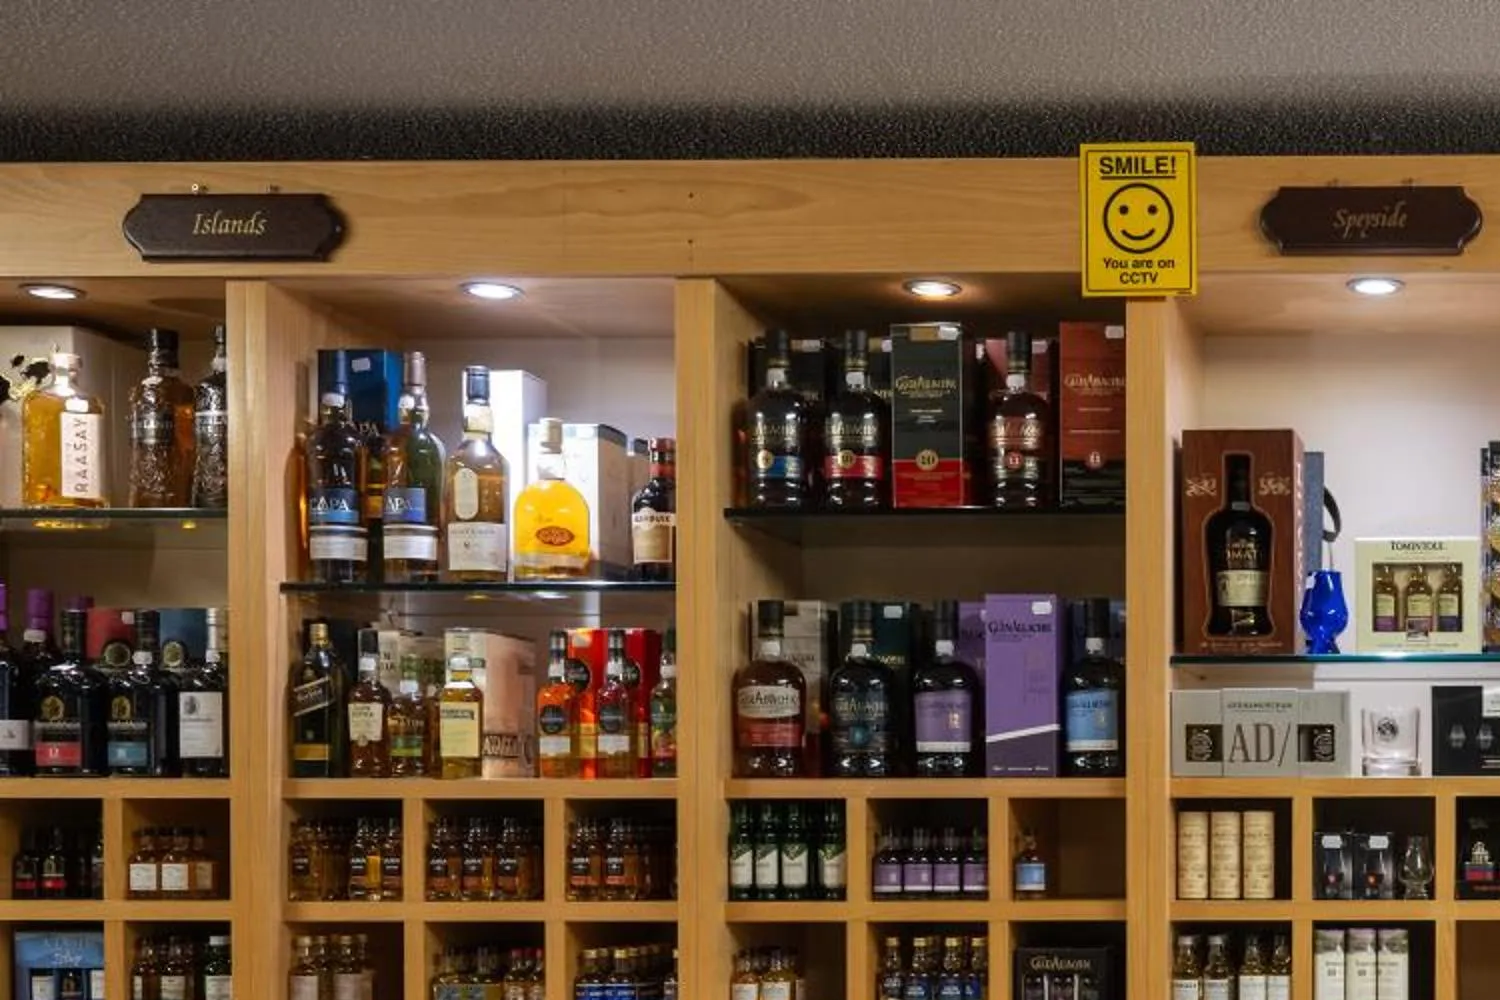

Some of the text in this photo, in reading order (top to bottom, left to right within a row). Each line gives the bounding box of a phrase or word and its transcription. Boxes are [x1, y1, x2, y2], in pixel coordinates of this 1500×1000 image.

[1099, 156, 1177, 175] SMILE!
[192, 212, 267, 237] Islands
[1333, 201, 1409, 238] Speyside
[1103, 257, 1175, 270] You are on
[1119, 271, 1159, 285] CCTV
[75, 417, 89, 493] RAASAY
